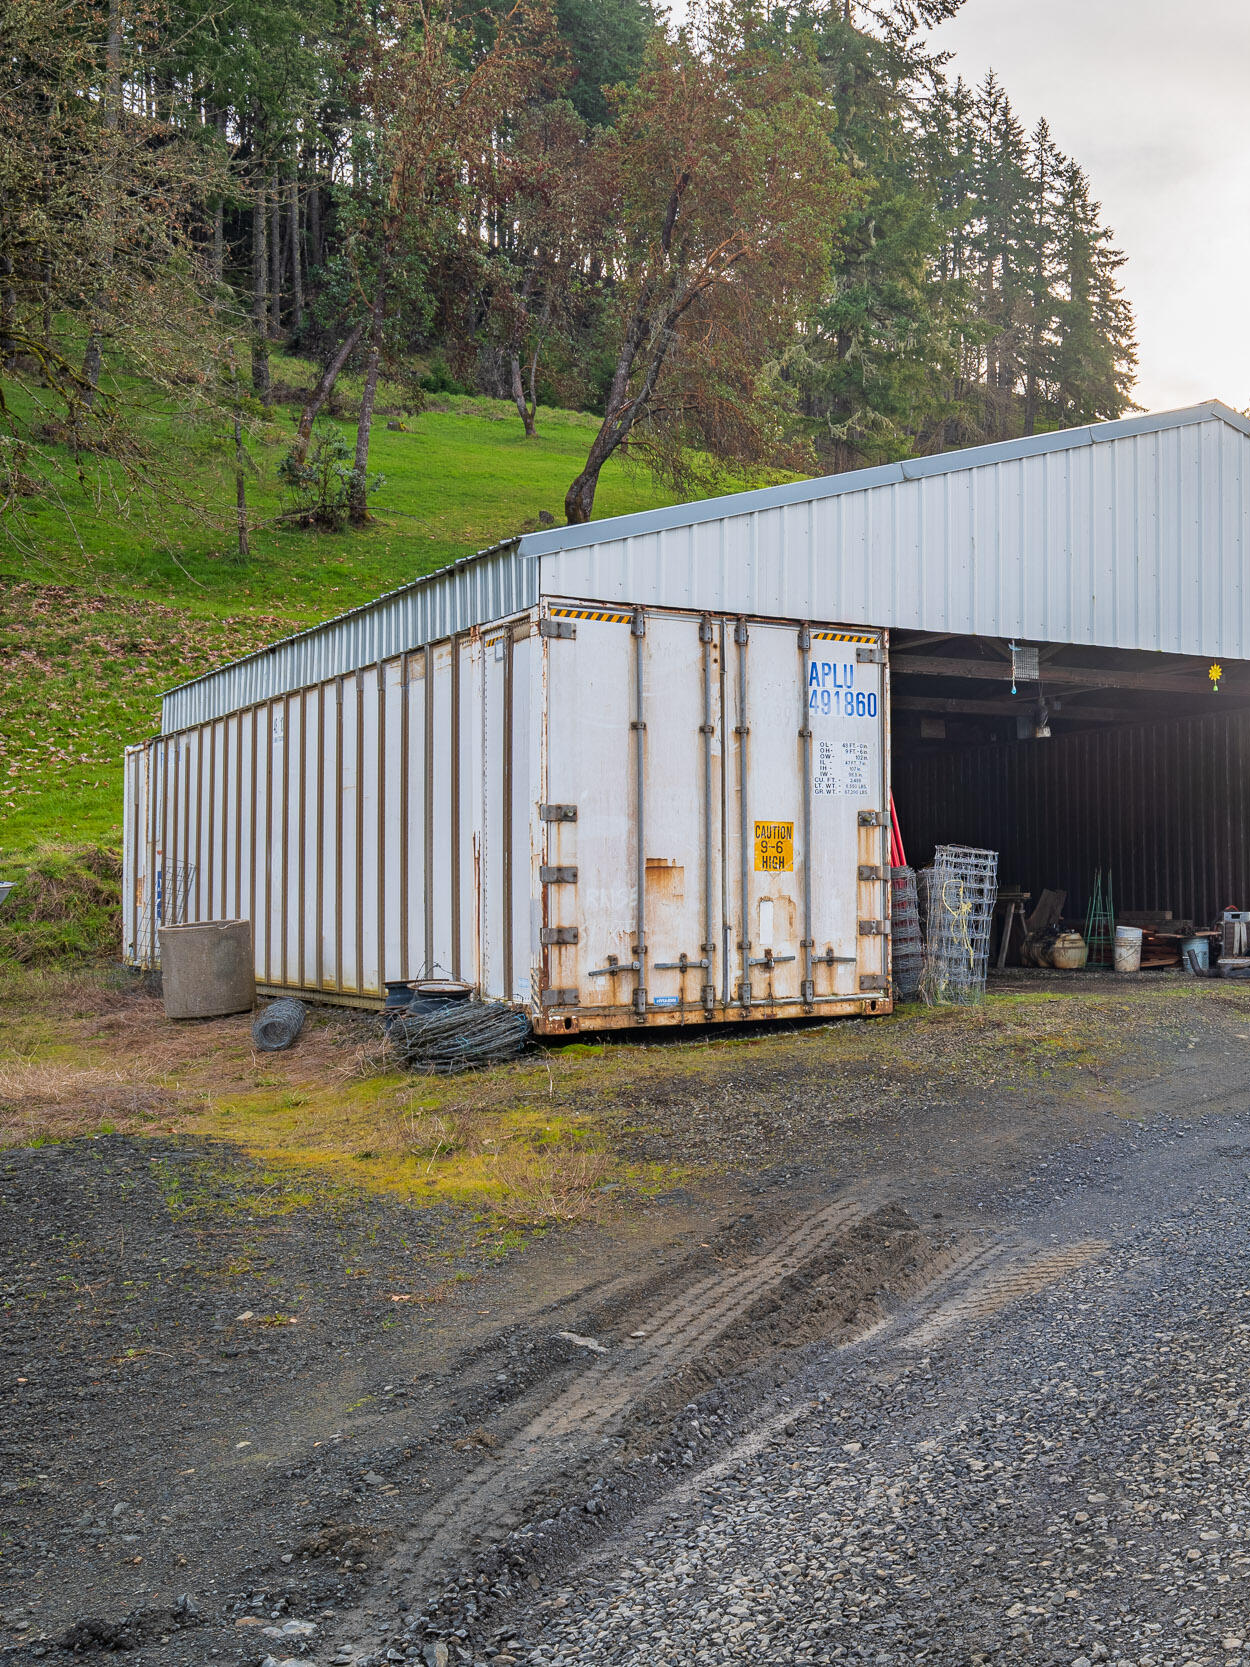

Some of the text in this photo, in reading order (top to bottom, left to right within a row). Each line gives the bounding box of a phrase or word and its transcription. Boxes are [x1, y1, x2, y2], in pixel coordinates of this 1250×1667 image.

[809, 661, 854, 689] APLU
[809, 689, 877, 718] 491860
[755, 824, 793, 840] CAUTION
[760, 840, 784, 854] 9-6
[761, 855, 785, 870] HIGH
